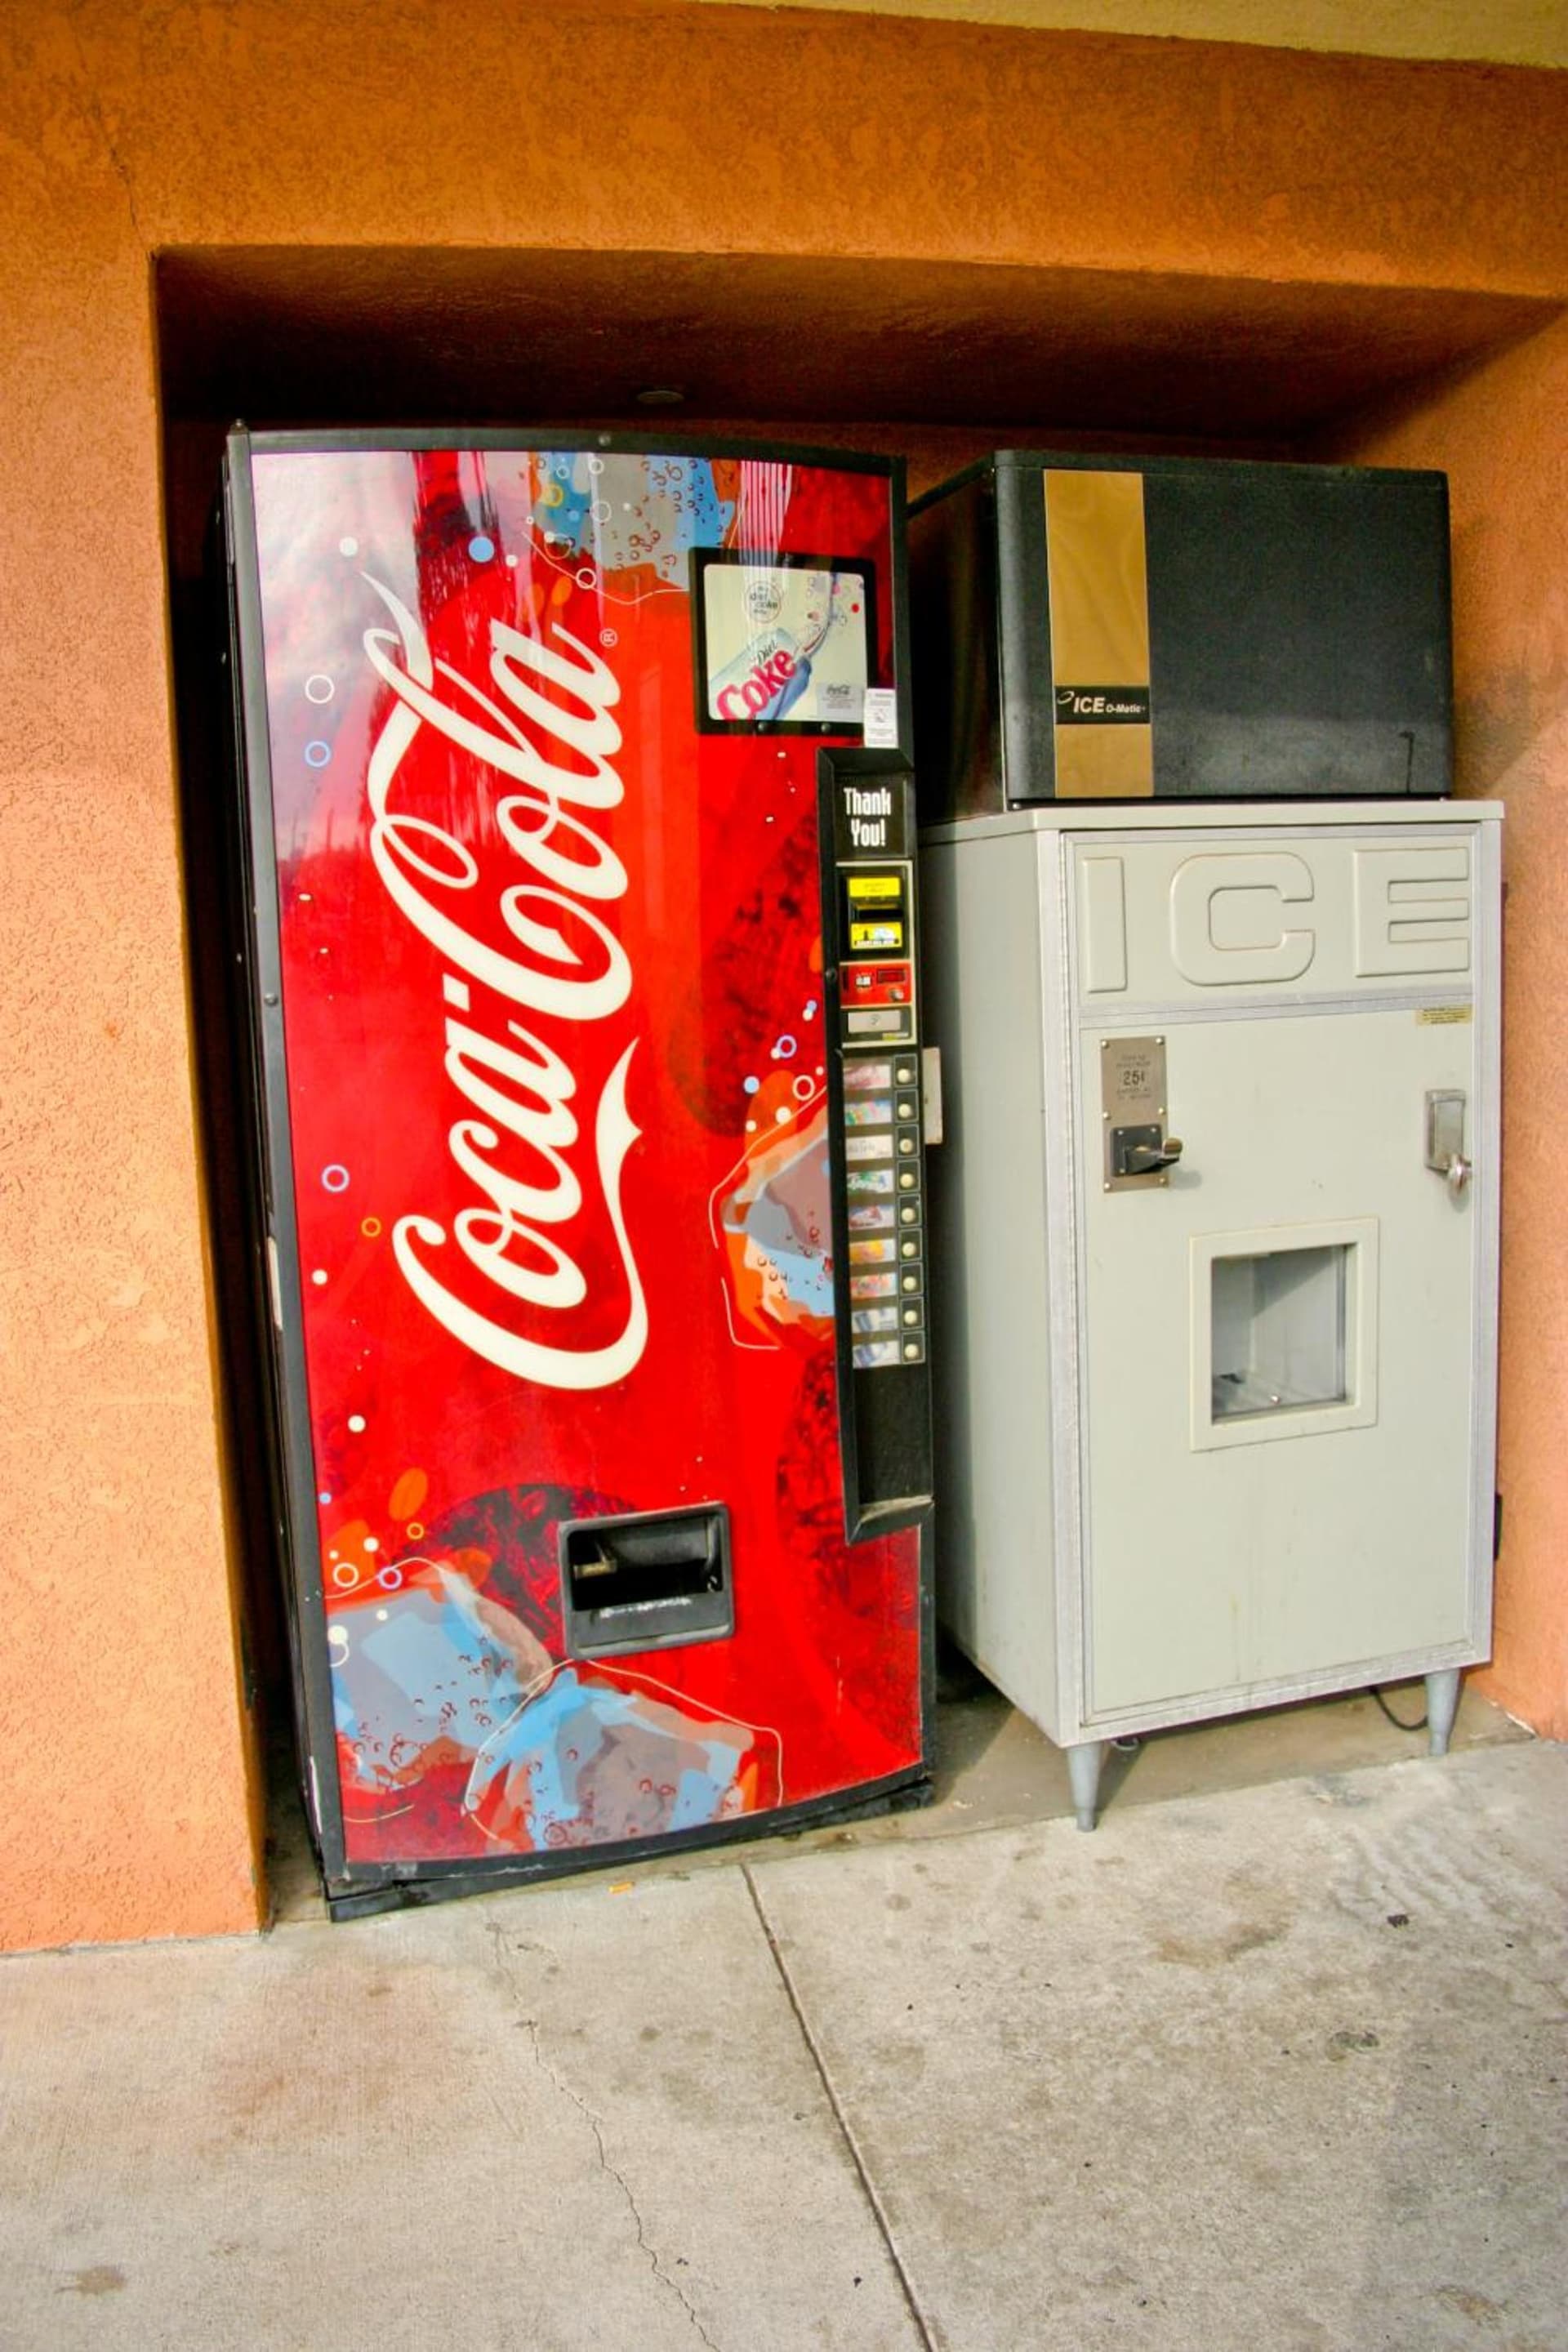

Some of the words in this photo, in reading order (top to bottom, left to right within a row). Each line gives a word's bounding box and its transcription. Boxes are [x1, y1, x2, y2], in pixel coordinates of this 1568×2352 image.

[717, 650, 796, 721] Coke
[1073, 696, 1105, 713] ICE
[843, 787, 891, 815] Thank
[851, 818, 885, 847] You!
[1082, 846, 1469, 993] ICE
[363, 572, 648, 1389] Coca-Cola
